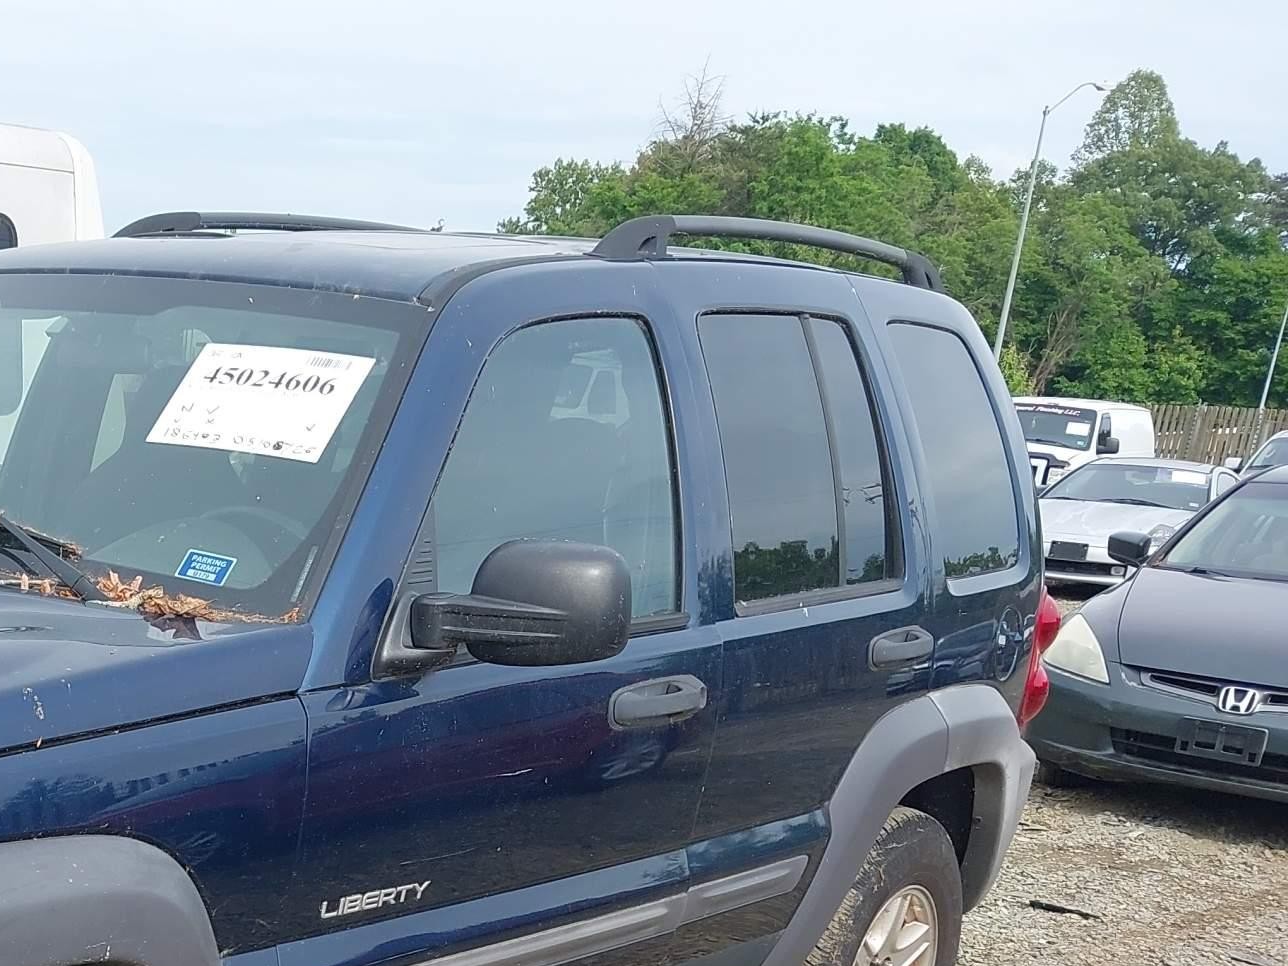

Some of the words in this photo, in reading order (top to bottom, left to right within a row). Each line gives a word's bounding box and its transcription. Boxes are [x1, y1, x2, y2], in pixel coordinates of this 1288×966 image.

[203, 366, 337, 395] 45024606
[190, 561, 221, 573] PERMIT
[192, 554, 227, 567] PARKING
[320, 880, 432, 919] LIBERTY
